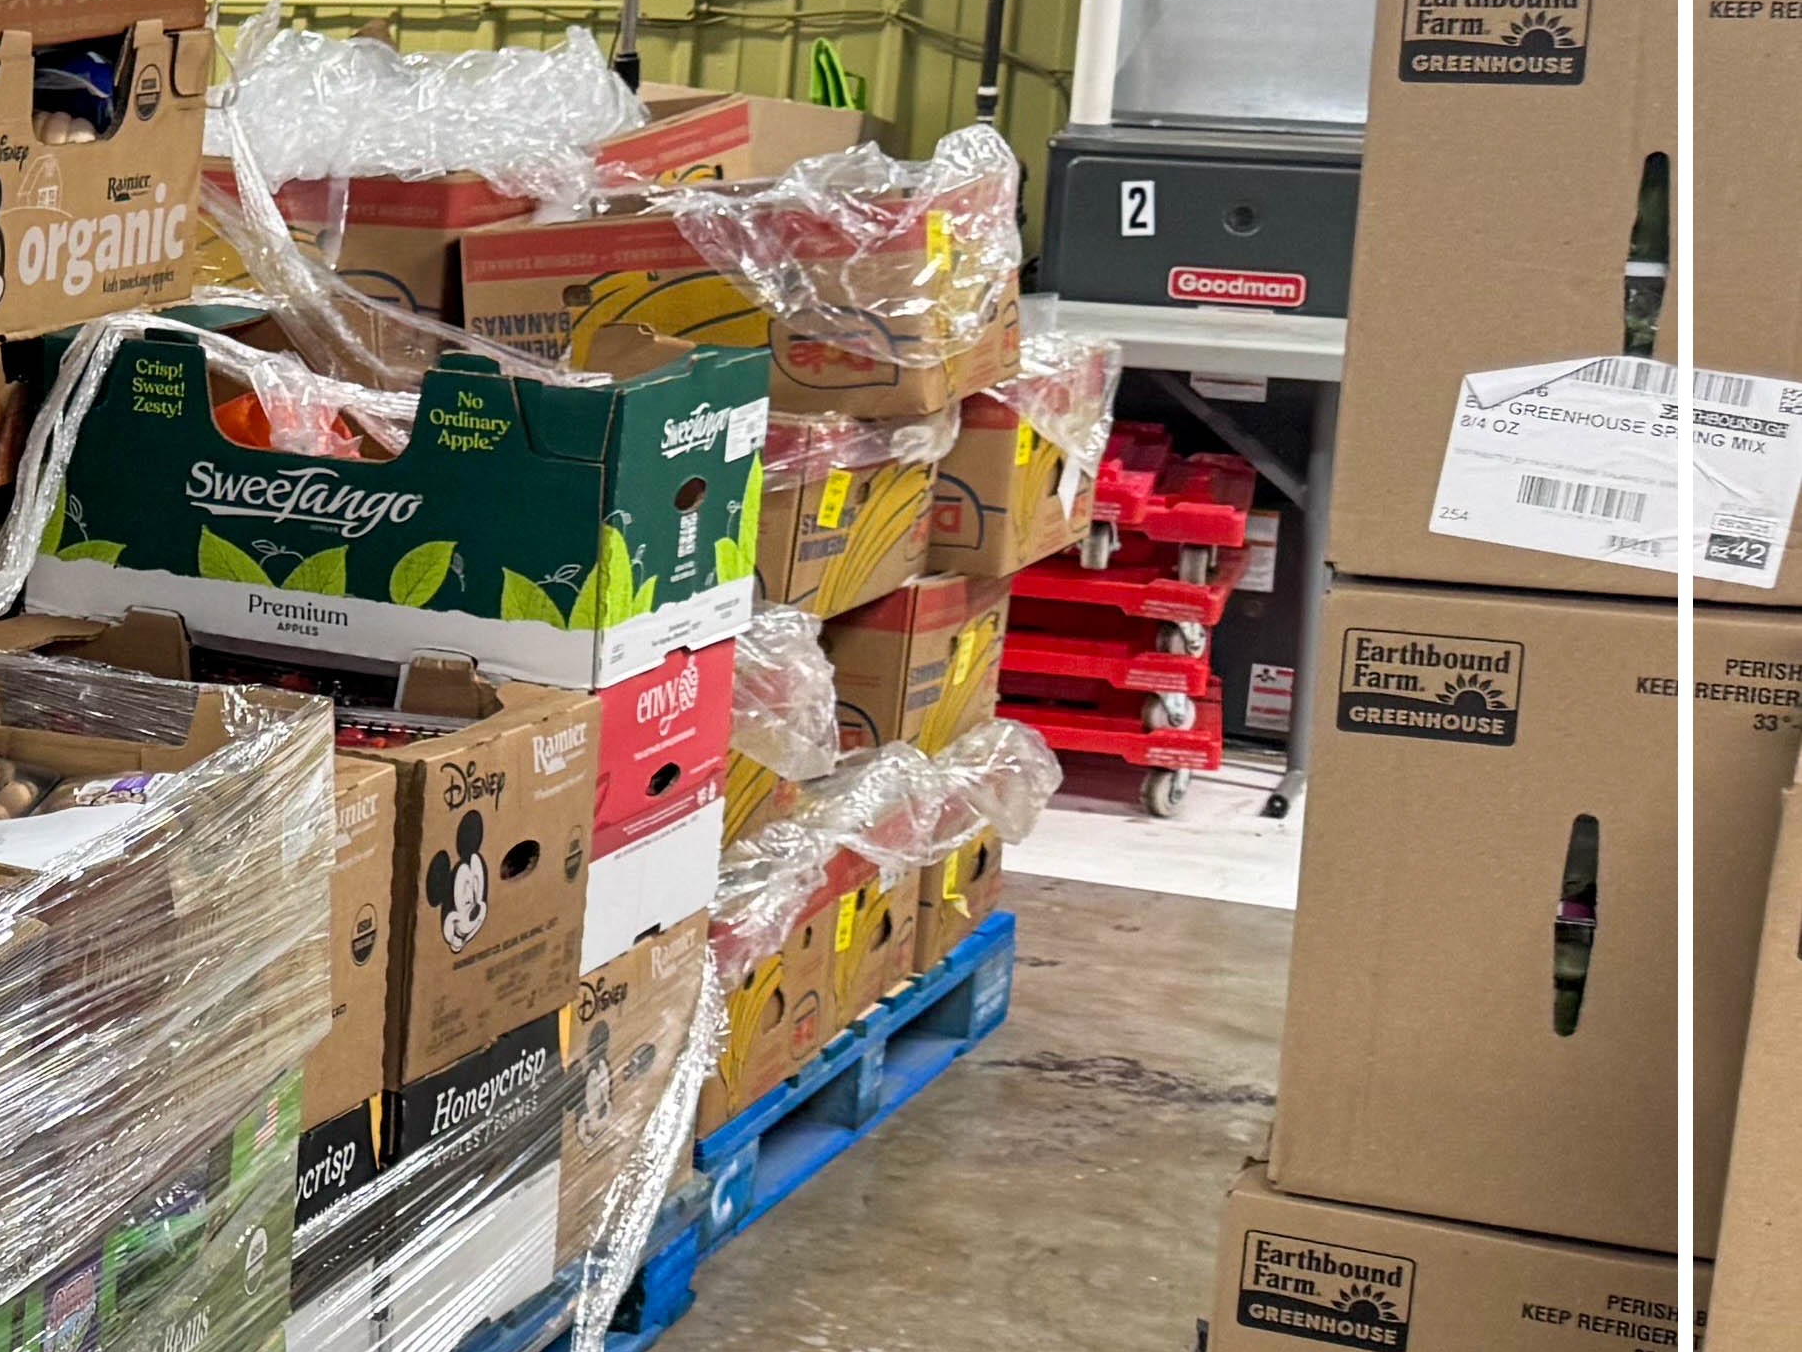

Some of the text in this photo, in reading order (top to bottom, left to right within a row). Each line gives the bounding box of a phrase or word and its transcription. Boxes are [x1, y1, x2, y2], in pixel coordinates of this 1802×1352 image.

[1709, 0, 1763, 19] KEEP
[1412, 54, 1574, 75] GREENHOUSE
[1128, 187, 1149, 229] 2
[18, 182, 187, 296] organic
[1177, 272, 1296, 299] Goodman
[470, 311, 573, 337] BANANAS
[135, 358, 184, 379] Crisp!
[131, 378, 186, 397] Sweet!
[457, 392, 484, 410] No
[132, 396, 183, 419] Zesty!
[429, 409, 511, 438] Ordinary
[1493, 419, 1520, 436] OZ
[1508, 402, 1767, 455] GREENHOUSE SPING MIX
[185, 461, 424, 538] SweeTango
[248, 594, 349, 627] Premium
[277, 621, 319, 637] APPLES
[1355, 637, 1511, 675] Earthbound
[1349, 705, 1506, 736] GREENHOUSE
[431, 1047, 547, 1136] Honeycrisp
[1256, 1241, 1404, 1287] Earthbound
[1248, 1302, 1397, 1345] GREENHOUSE
[1521, 1303, 1572, 1325] KEEP
